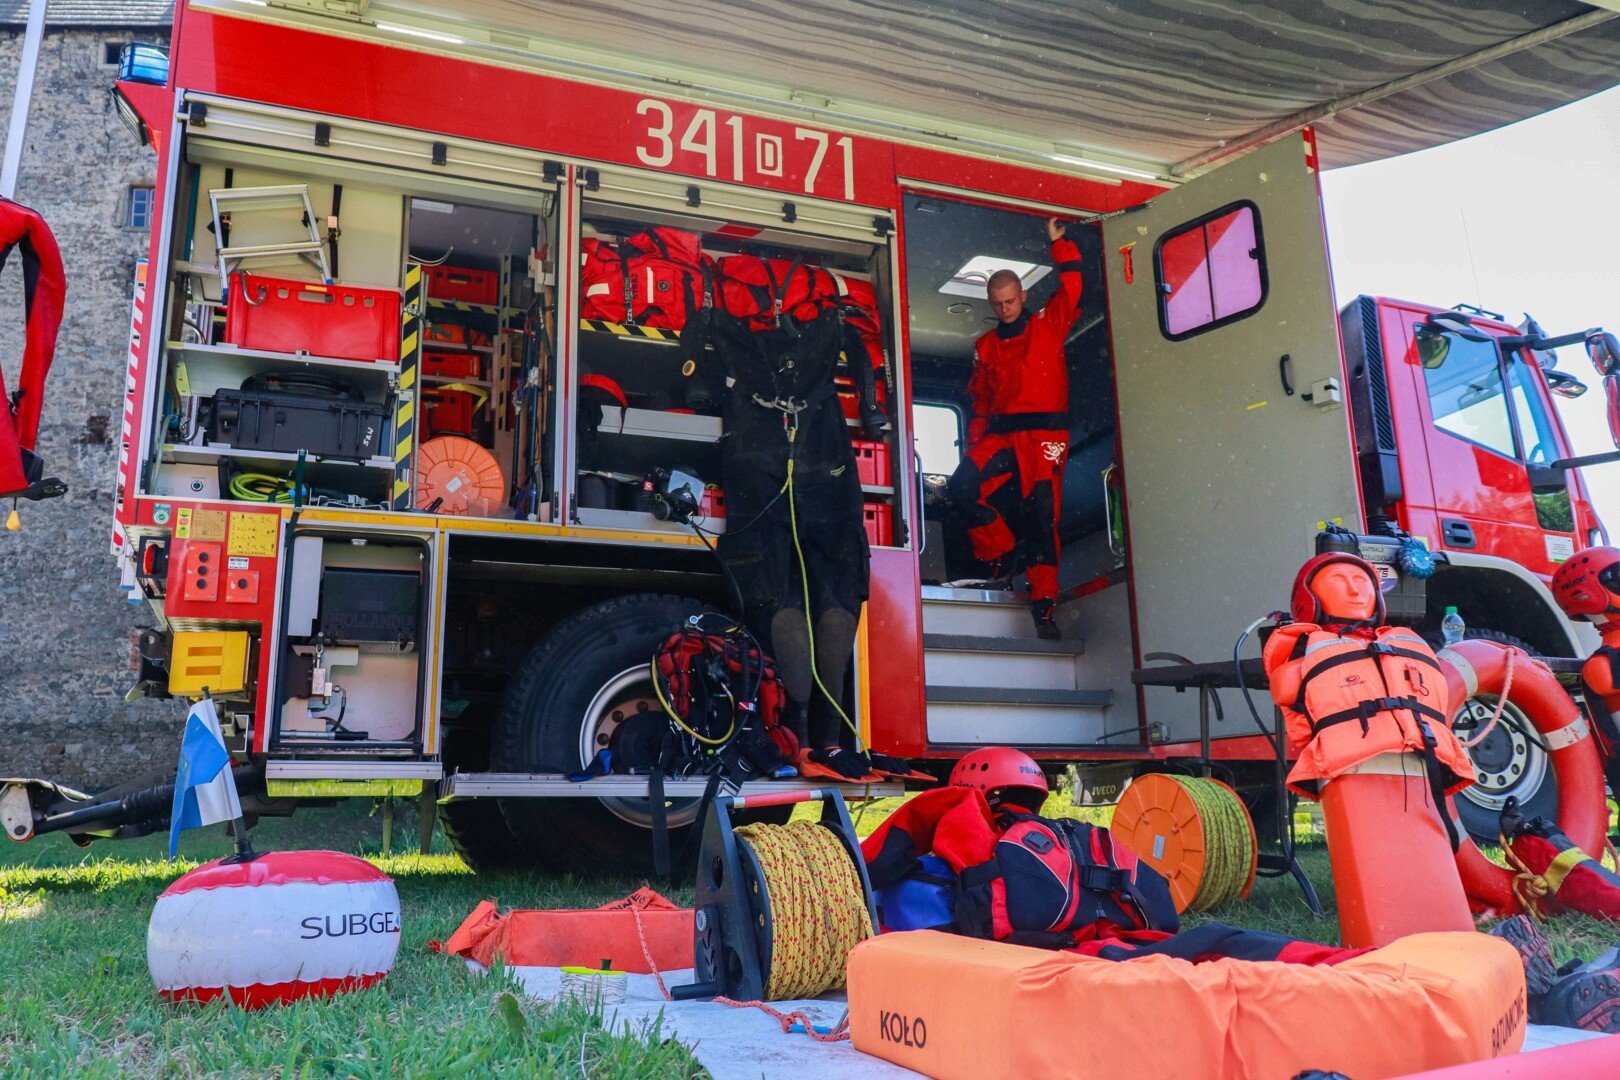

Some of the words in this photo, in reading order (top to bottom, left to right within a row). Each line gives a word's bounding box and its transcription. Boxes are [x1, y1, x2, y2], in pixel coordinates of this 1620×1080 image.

[636, 98, 744, 182] 341
[795, 126, 855, 201] 71
[1092, 785, 1117, 796] IVECO
[880, 1010, 927, 1049] KOŁO
